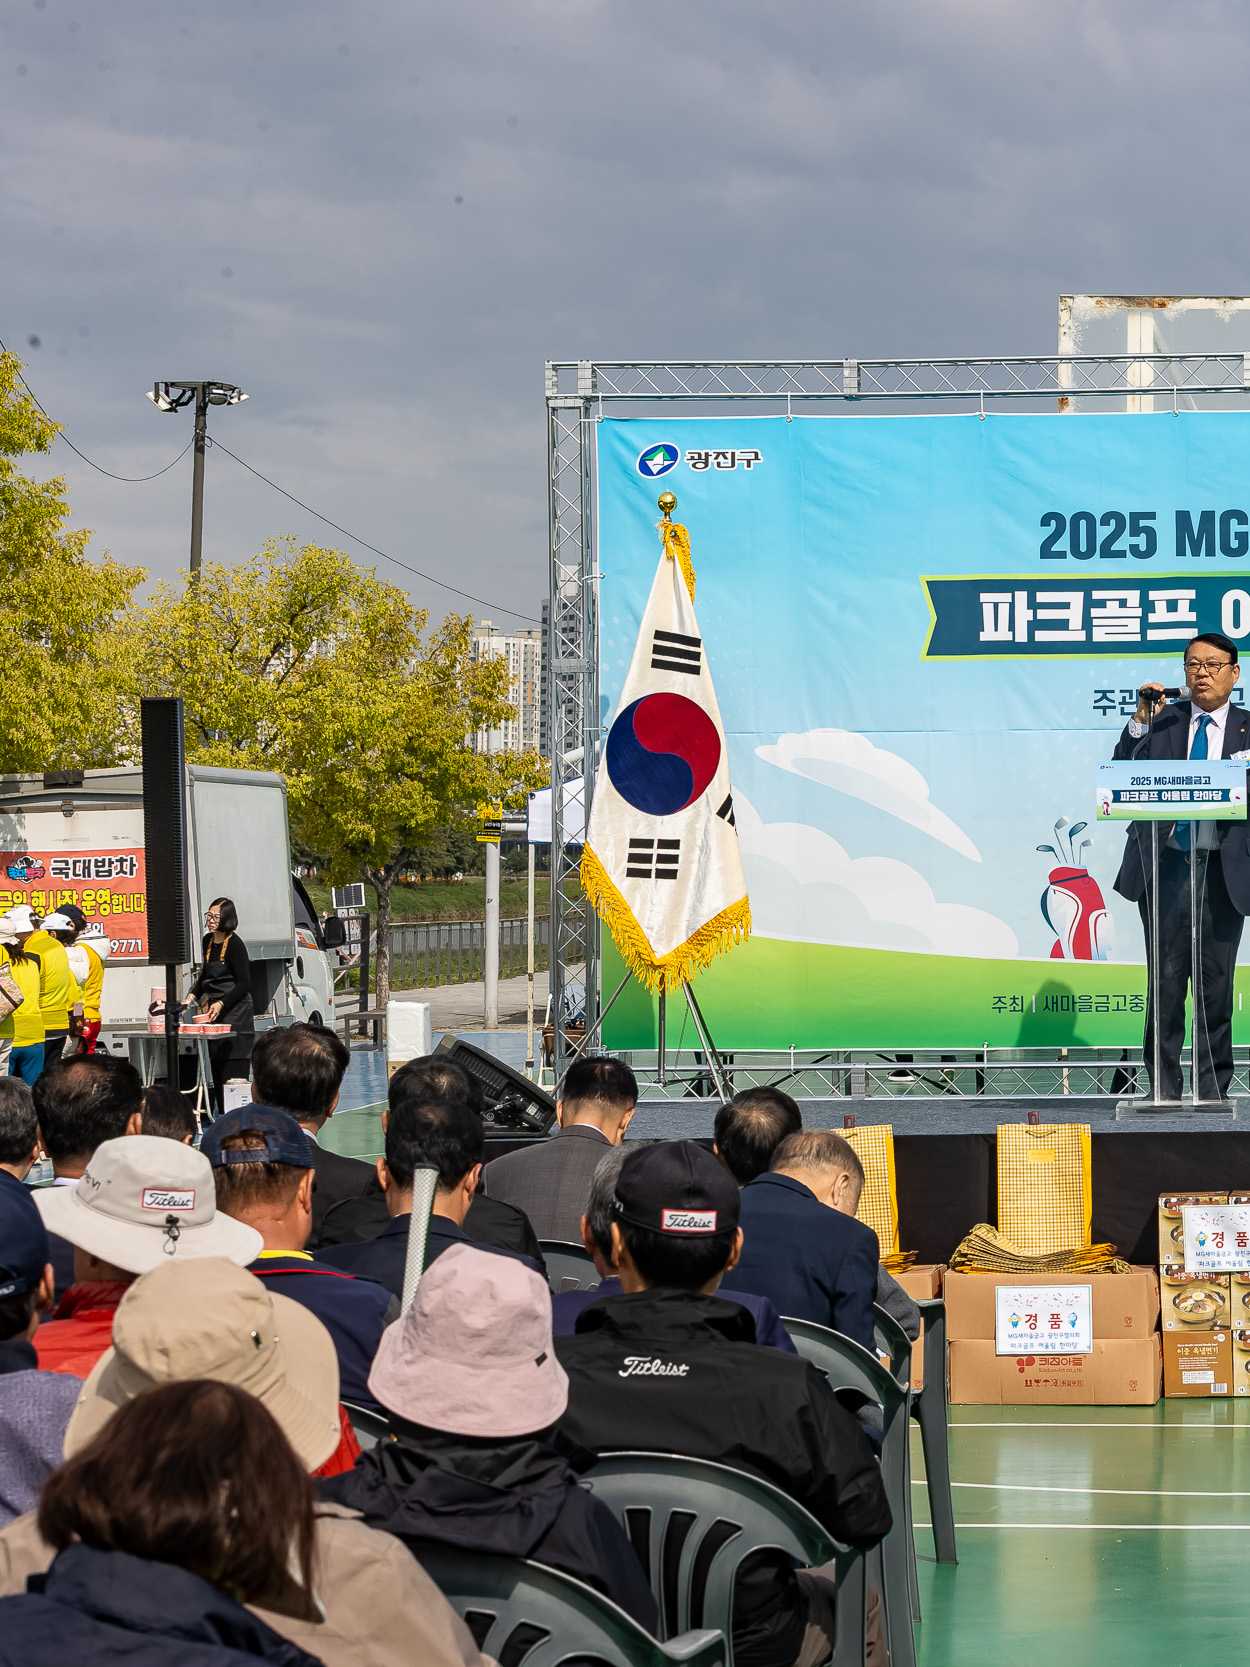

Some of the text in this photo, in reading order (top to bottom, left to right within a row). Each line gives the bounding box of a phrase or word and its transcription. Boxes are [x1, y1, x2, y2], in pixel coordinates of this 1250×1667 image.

[686, 451, 761, 470] 광진구
[1039, 511, 1157, 560] 2025
[979, 589, 1199, 643] 파크골프
[1131, 775, 1211, 785] 2025 MG새마을금고
[1120, 790, 1222, 801] 파크골프 어울림 한마당
[51, 856, 137, 879] 국대밥차
[81, 888, 145, 917] 운영합니다
[992, 994, 1024, 1013] 주최
[145, 1192, 194, 1207] Titleist
[665, 1213, 713, 1230] Titleist
[618, 1356, 690, 1377] Titleist
[1039, 1357, 1082, 1366] 키친아트
